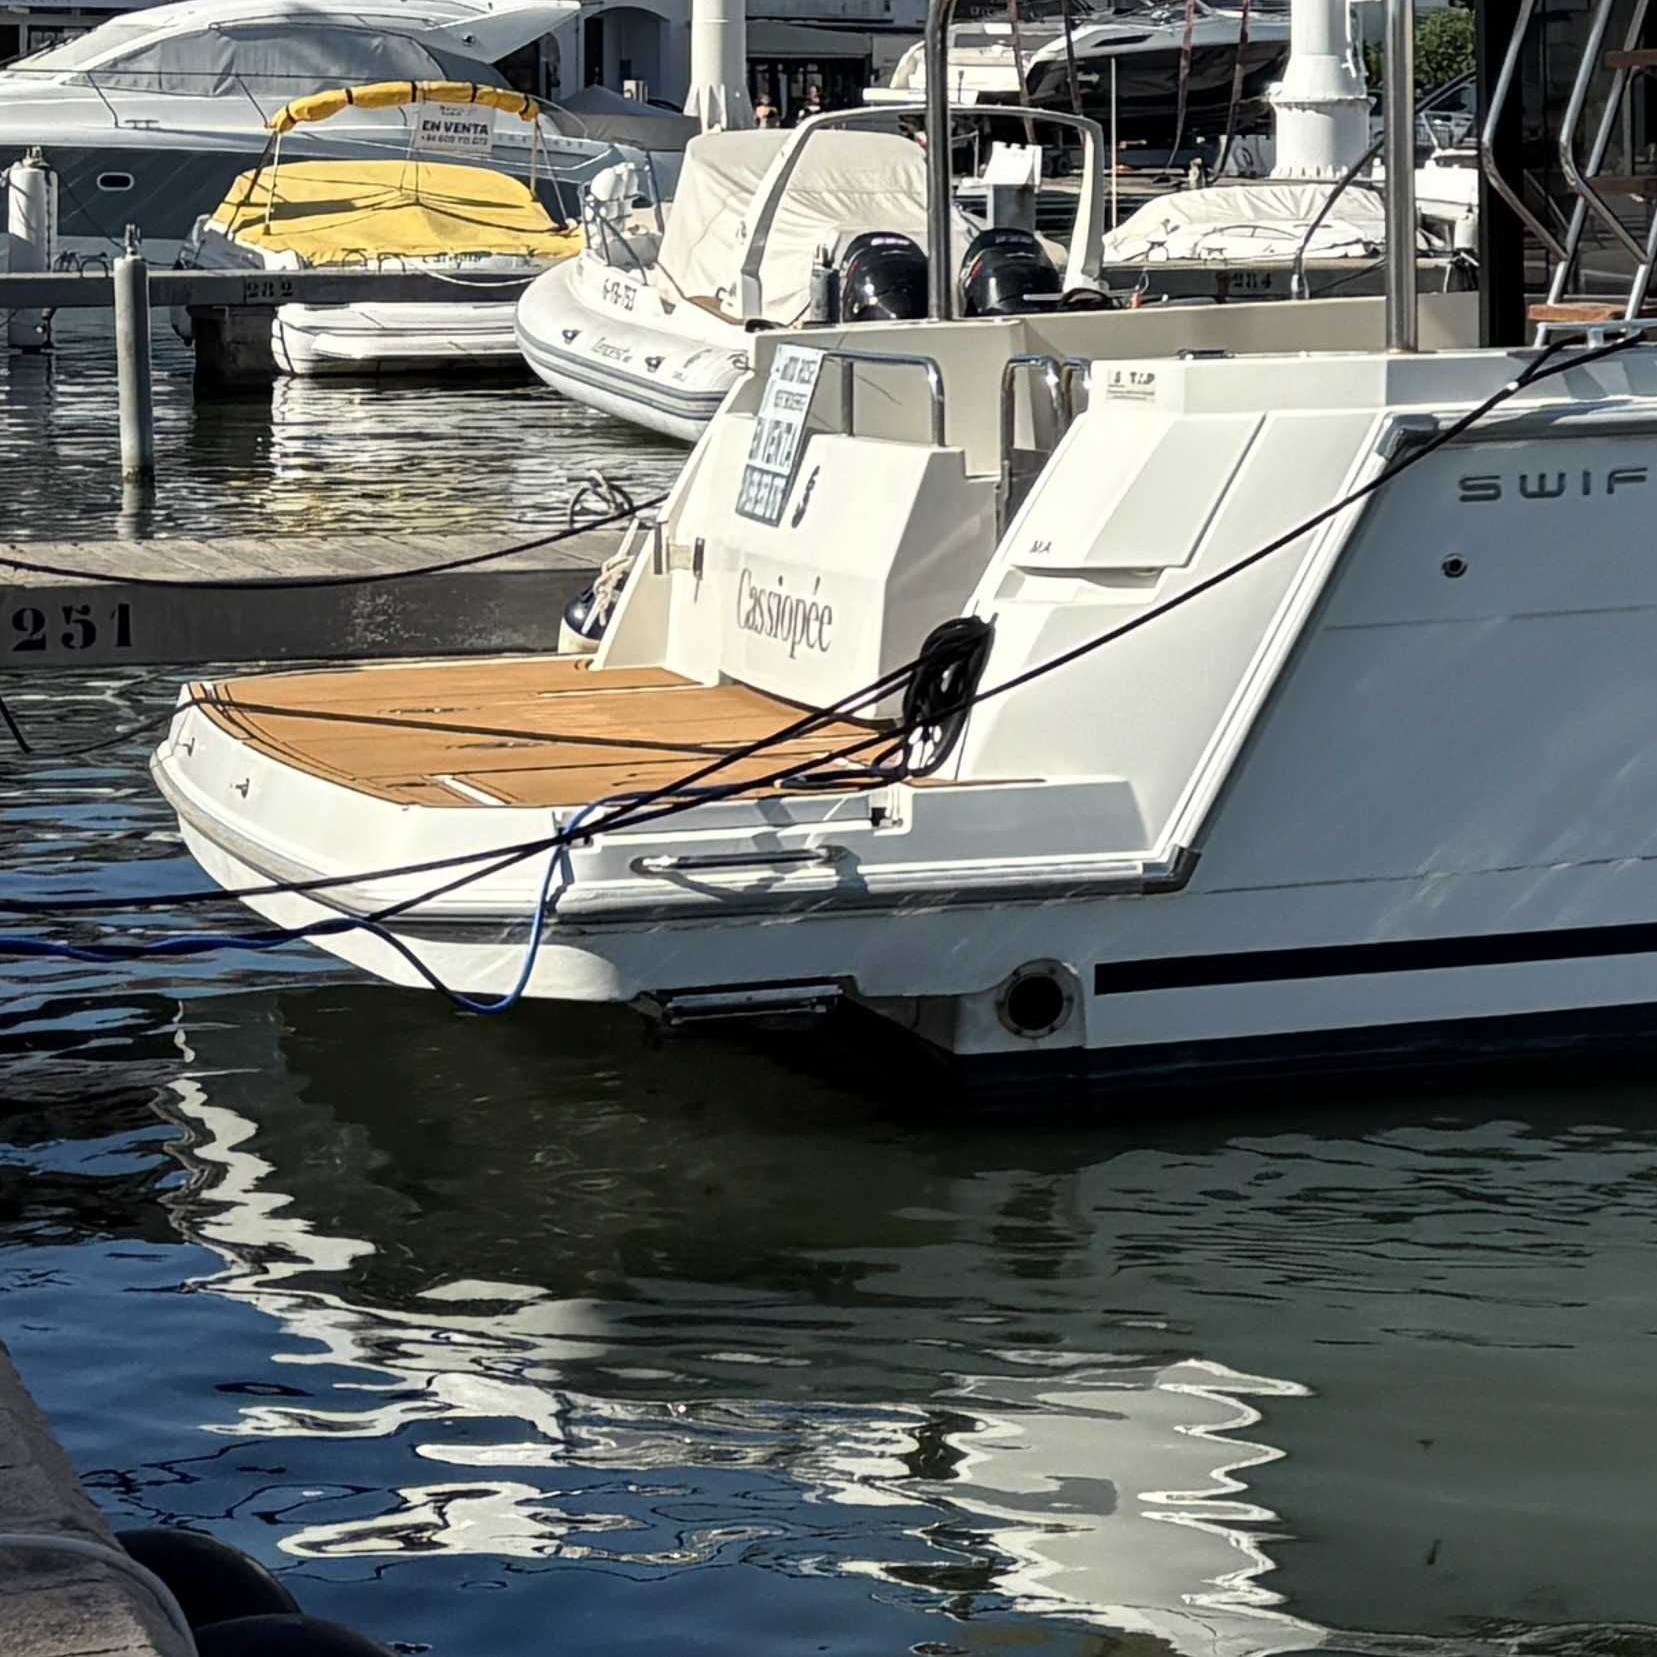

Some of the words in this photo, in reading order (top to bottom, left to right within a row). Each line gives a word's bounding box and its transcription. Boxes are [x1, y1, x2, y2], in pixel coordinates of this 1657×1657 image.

[421, 119, 441, 132] EN
[444, 120, 489, 136] VENTA
[11, 603, 132, 652] 251
[736, 566, 833, 660] Cassiopée
